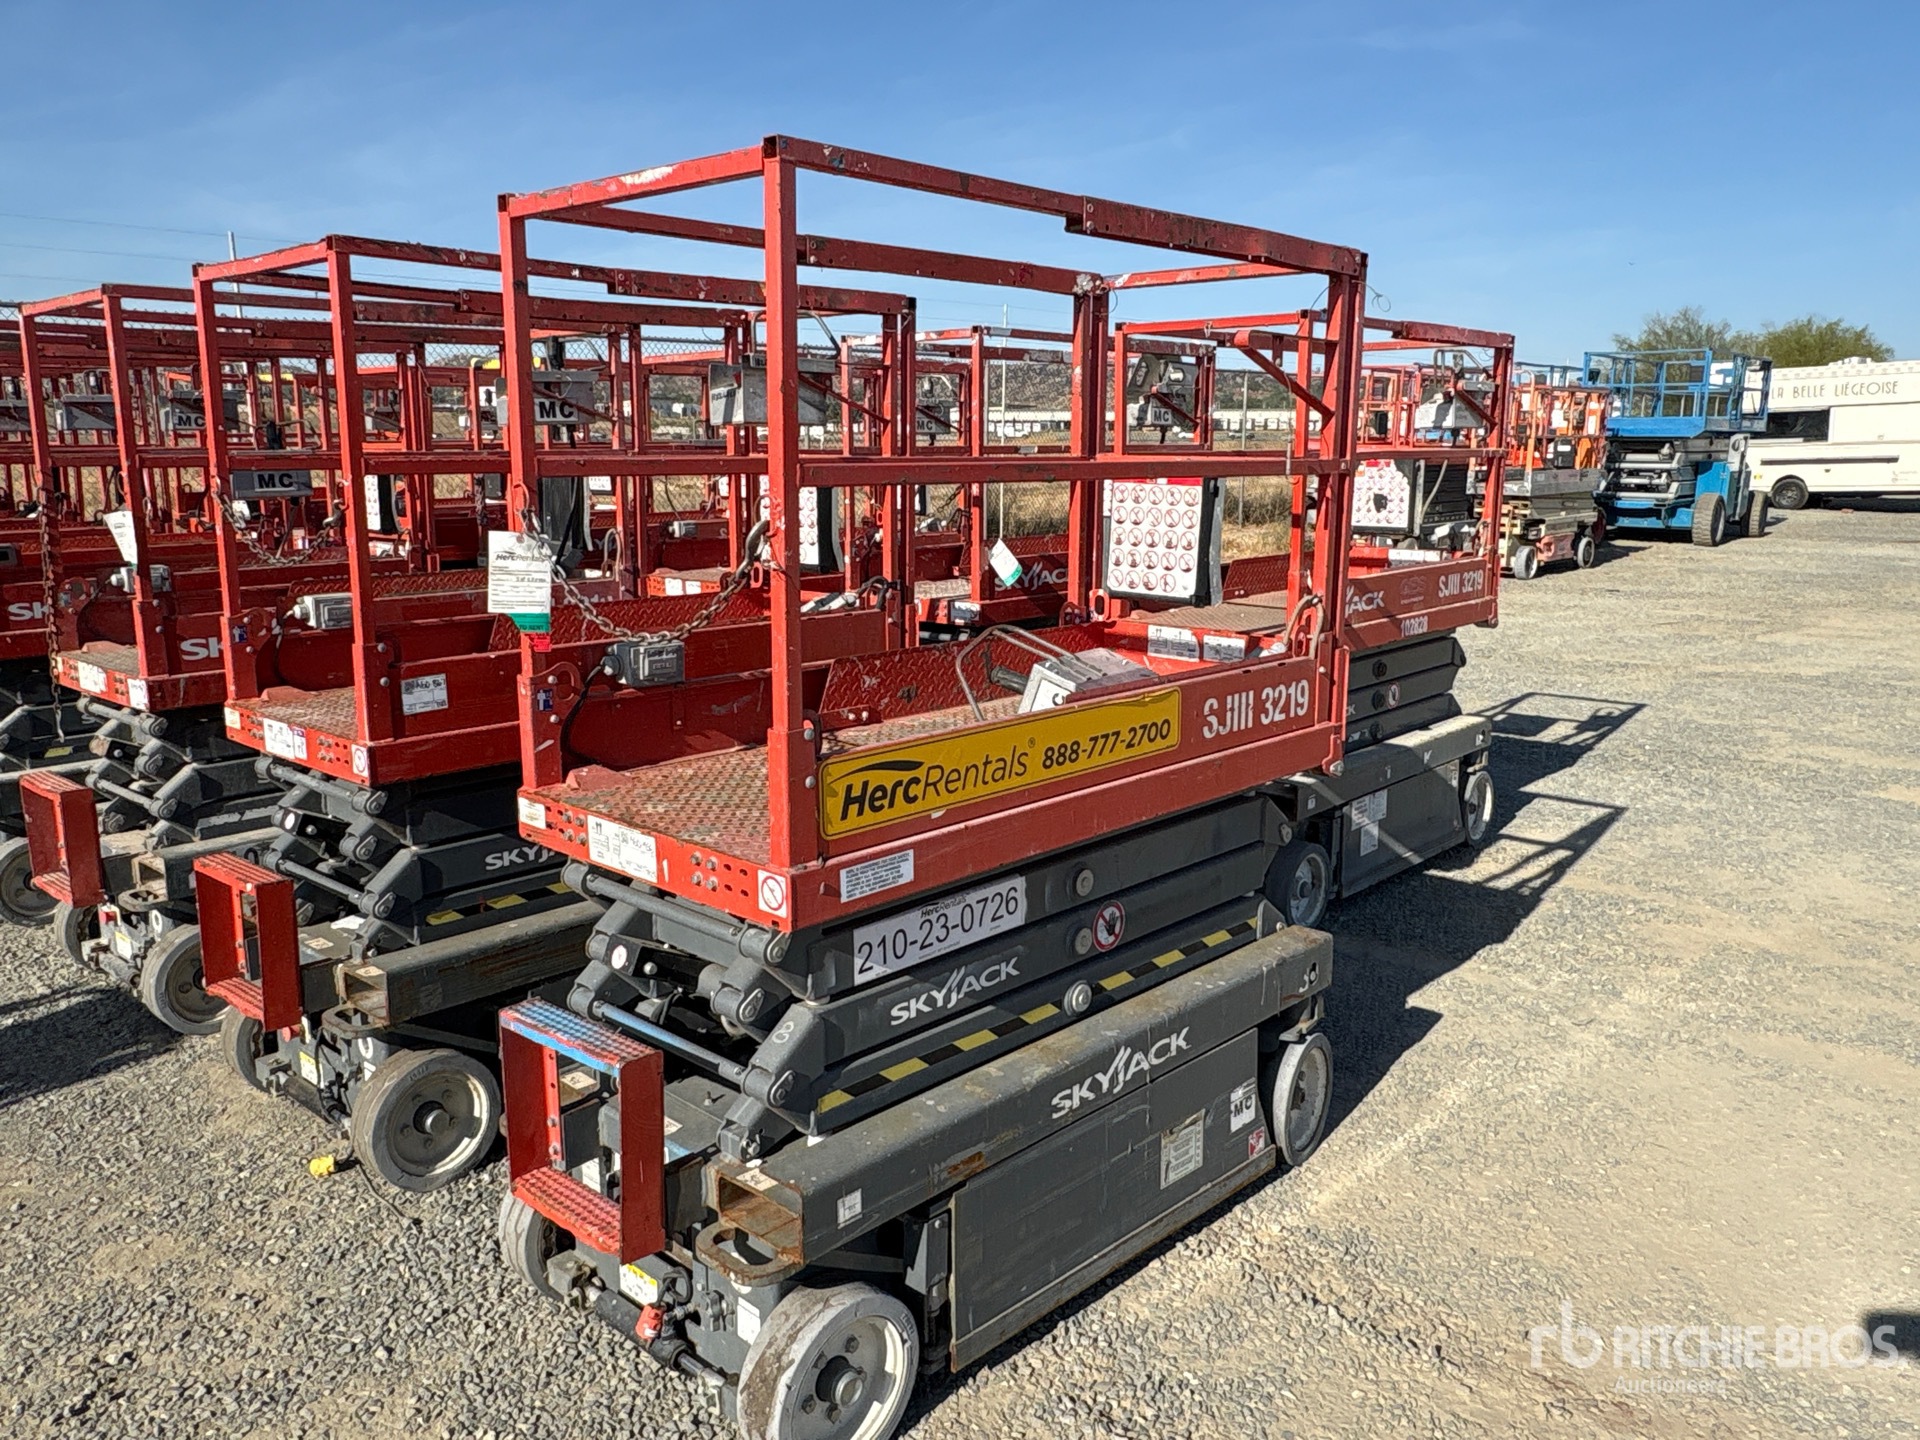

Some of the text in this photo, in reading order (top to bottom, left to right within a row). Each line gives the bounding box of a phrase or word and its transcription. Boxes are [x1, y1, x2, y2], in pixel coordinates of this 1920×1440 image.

[1793, 384, 1825, 398] BELLE
[177, 414, 205, 426] MC
[538, 401, 574, 419] MC
[1153, 409, 1169, 422] MC
[916, 420, 933, 431] MC
[257, 473, 294, 488] MC
[1462, 569, 1484, 594] 3219
[1260, 679, 1309, 725] 3219
[1042, 718, 1171, 770] 888-777-2700
[857, 886, 1019, 975] 210-23-0726
[890, 956, 1021, 1026] SKYJACK
[1051, 1026, 1192, 1120] SKYJACK
